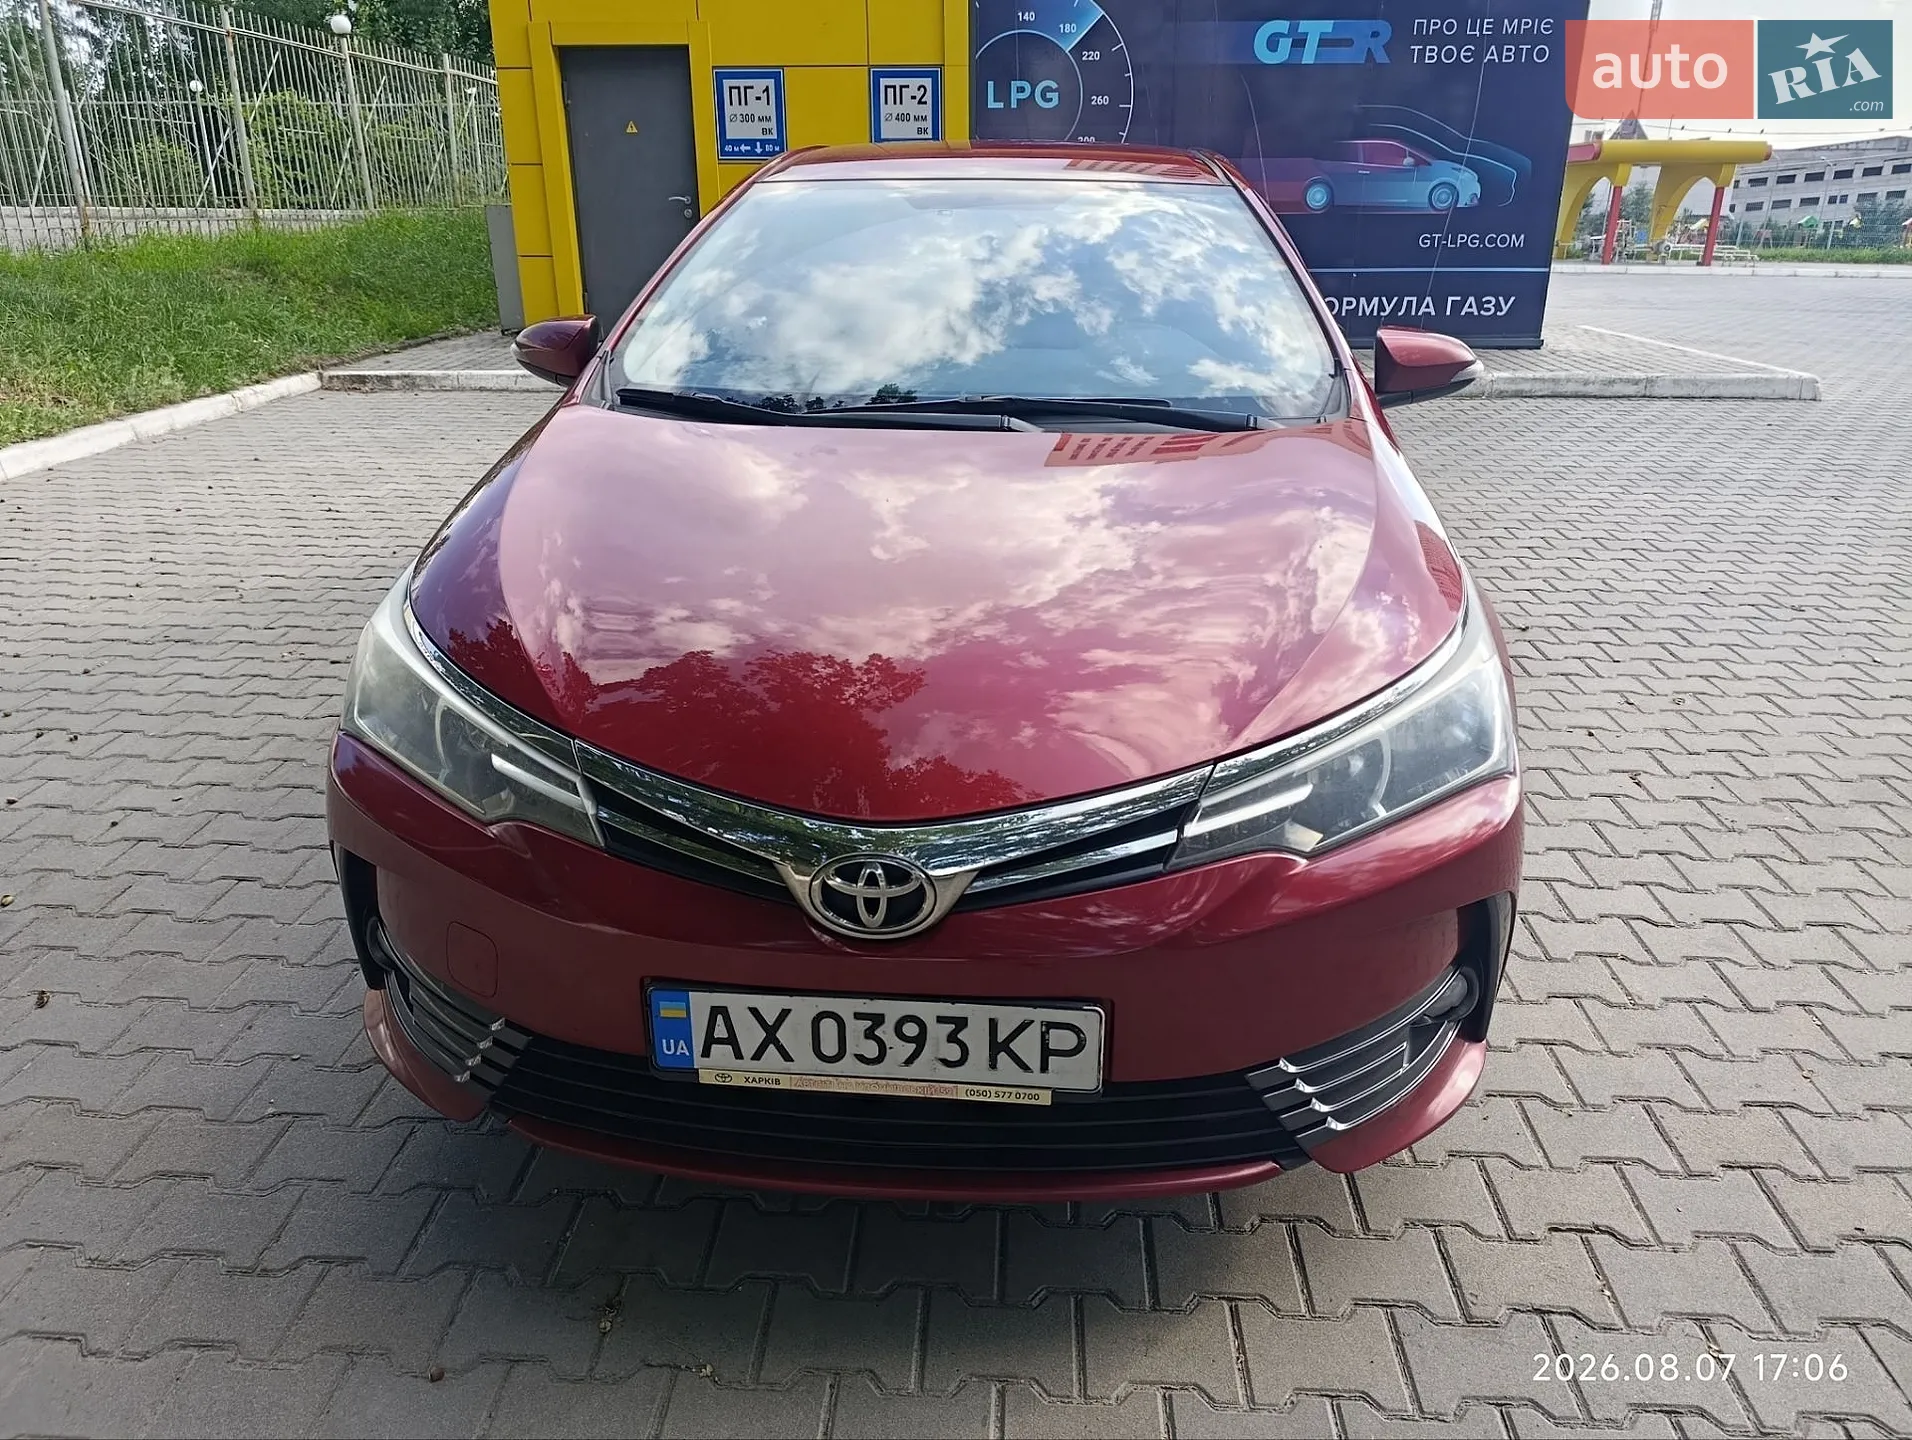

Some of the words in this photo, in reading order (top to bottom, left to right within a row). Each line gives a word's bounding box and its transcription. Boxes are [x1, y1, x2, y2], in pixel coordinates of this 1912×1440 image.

[1017, 11, 1036, 21] 140
[1059, 23, 1077, 33] 180
[1412, 18, 1458, 36] ПРО
[1466, 18, 1495, 38] ЦЕ
[1501, 18, 1555, 36] МРІЄ
[1082, 51, 1100, 61] 220
[1411, 45, 1476, 64] ТВОЄ
[1483, 44, 1551, 64] АВТО
[728, 85, 771, 106] ПГ-1
[884, 84, 928, 106] ПГ-2
[987, 79, 1060, 109] LPG
[1091, 95, 1110, 105] 260
[739, 113, 756, 123] 300
[895, 112, 911, 122] 400
[761, 127, 774, 136] ВК
[917, 126, 929, 136] ВК
[1418, 233, 1525, 248] GT-LPG.COM
[1325, 296, 1436, 317] ОРМУЛА
[1446, 295, 1516, 317] ГАЗУ
[662, 1038, 690, 1057] UA
[700, 1004, 796, 1063] AX
[811, 1009, 969, 1069] 0393
[987, 1016, 1087, 1075] KP
[743, 1076, 782, 1086] ХАРКІВ
[965, 1088, 992, 1099] (050)
[994, 1090, 1013, 1099] 577
[1015, 1091, 1040, 1101] 0700
